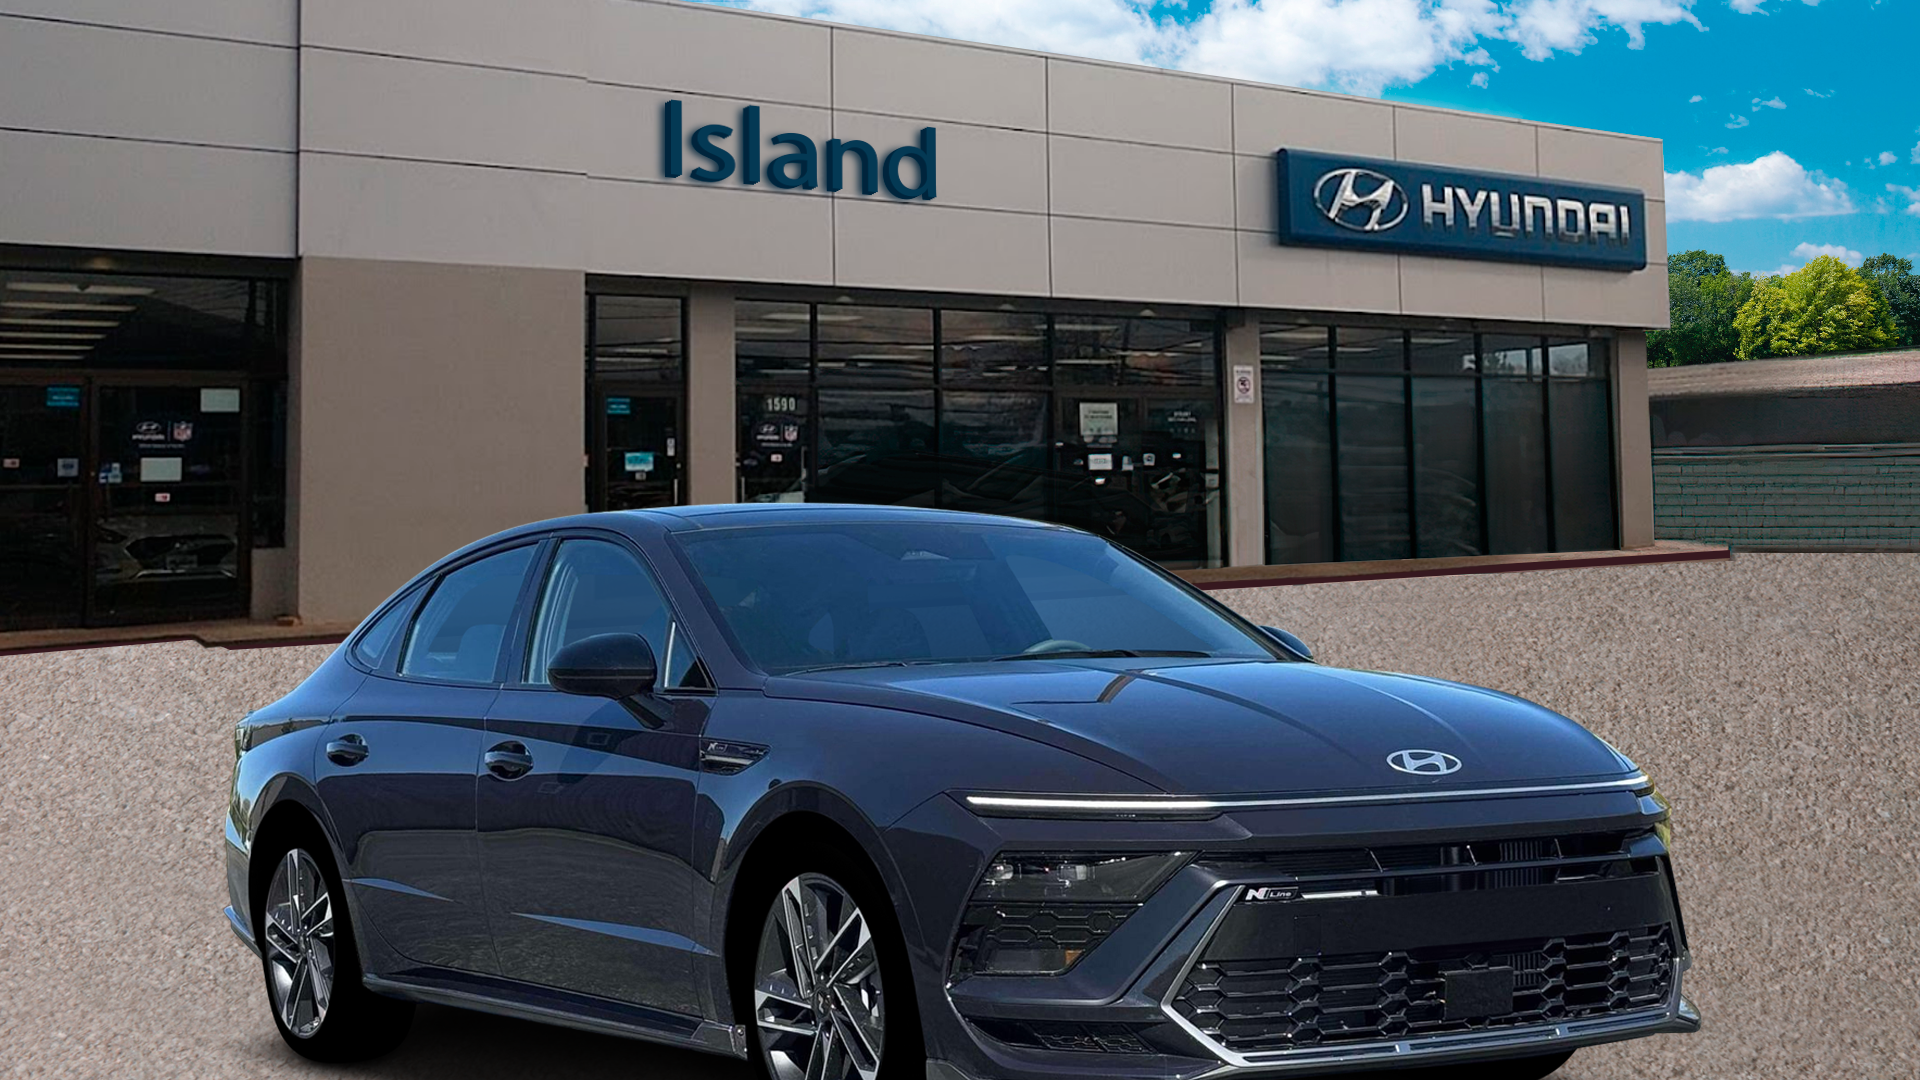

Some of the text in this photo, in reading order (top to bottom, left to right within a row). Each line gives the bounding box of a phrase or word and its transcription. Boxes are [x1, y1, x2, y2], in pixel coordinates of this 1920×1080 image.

[664, 99, 937, 201] Island
[1422, 184, 1630, 244] HYUNDAI
[767, 397, 796, 411] 1590
